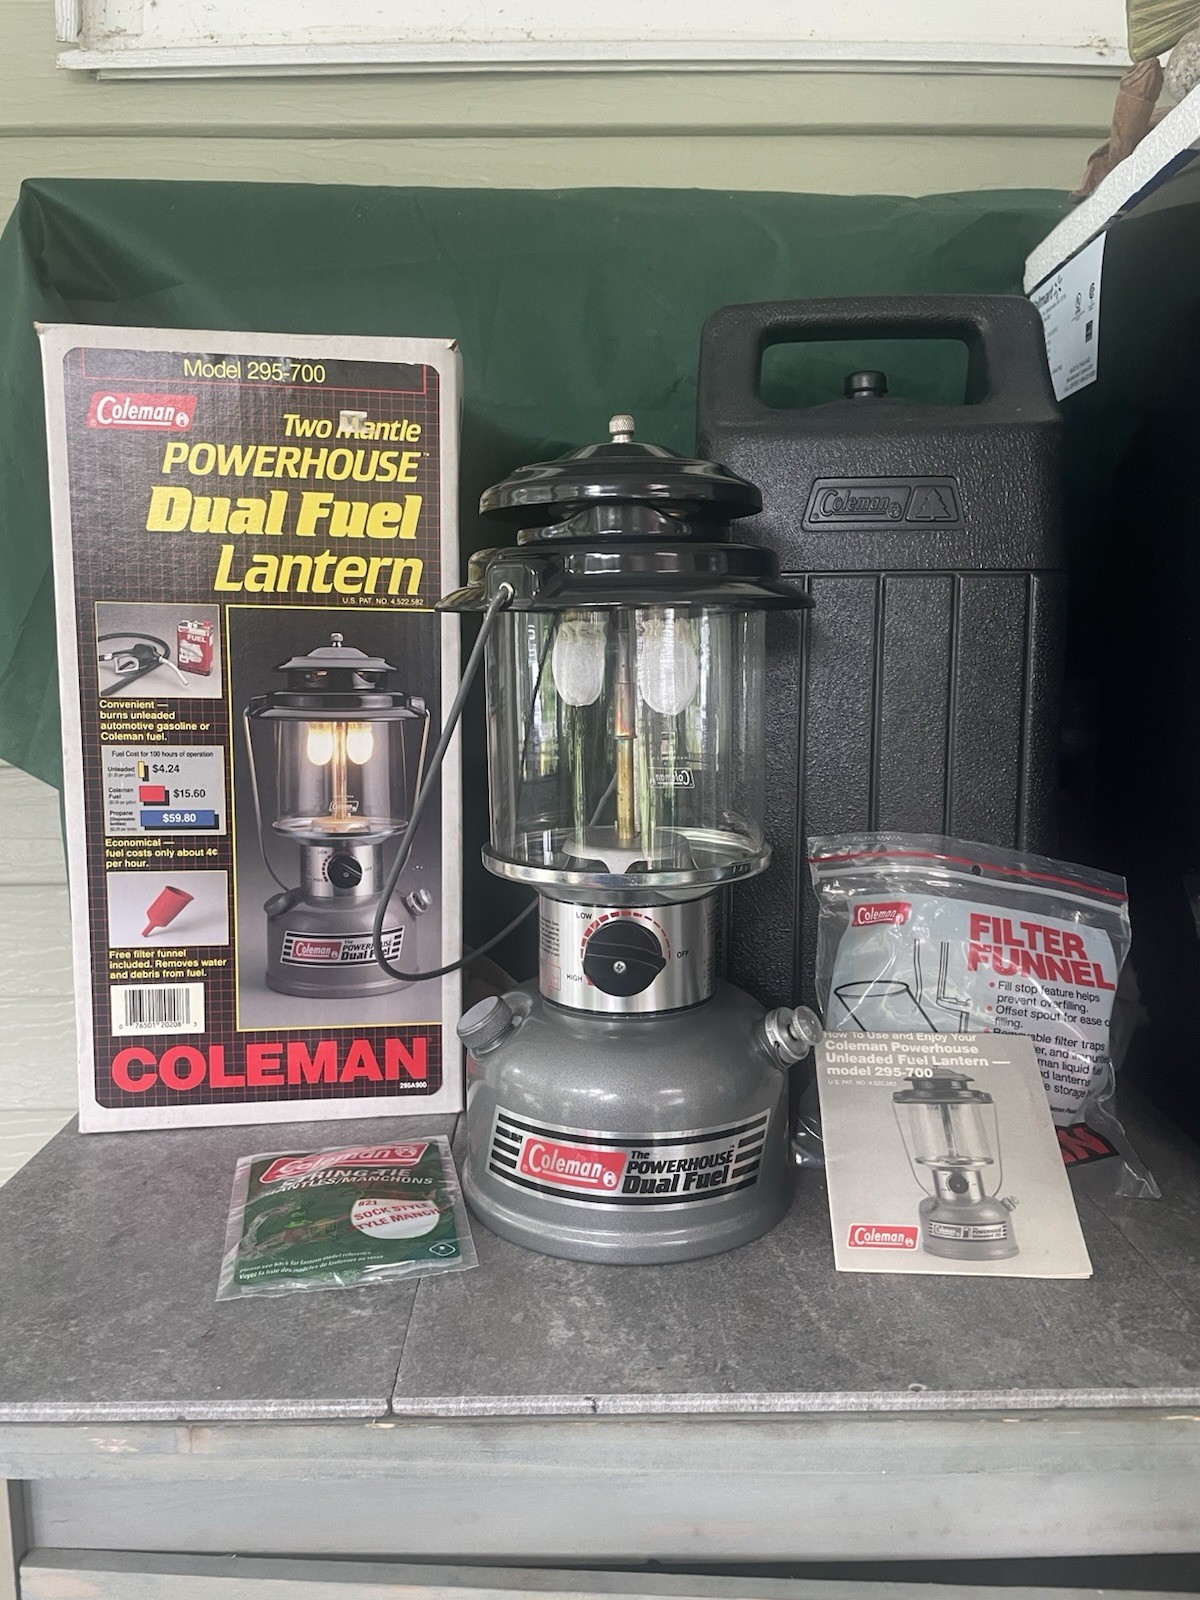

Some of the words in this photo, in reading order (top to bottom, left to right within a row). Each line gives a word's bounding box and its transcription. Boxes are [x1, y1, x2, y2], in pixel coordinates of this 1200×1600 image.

[183, 359, 241, 379] Model
[247, 362, 326, 383] 295-700
[97, 396, 175, 426] Coleman
[283, 413, 333, 438] Two
[162, 442, 421, 483] POWERHOUSE
[820, 489, 890, 517] Coleman
[146, 486, 288, 536] Dual
[296, 492, 423, 540] Fuel
[213, 545, 424, 595] Lantern
[187, 634, 206, 643] FUEL
[99, 700, 155, 709] Convenient
[100, 711, 129, 720] burns
[131, 711, 176, 720] unleaded
[100, 722, 154, 731] automotive
[156, 722, 198, 732] gasoline
[200, 723, 210, 731] or
[101, 732, 144, 741] Coleman
[146, 732, 168, 741] fuel.
[152, 764, 180, 773] $4.24
[173, 789, 206, 799] $15.60
[162, 813, 197, 823] $59.80
[105, 839, 161, 847] Economical
[105, 849, 125, 858] fuel
[126, 849, 152, 857] costs
[154, 849, 175, 859] only
[177, 848, 204, 857] about
[106, 860, 122, 870] per
[125, 859, 149, 868] hour.
[576, 911, 593, 920] LOW
[858, 907, 897, 924] Coleman
[970, 913, 1088, 960] FILTER
[109, 951, 131, 959] Free
[133, 950, 155, 958] filter
[157, 949, 187, 958] funnel
[296, 942, 331, 957] Coleman
[341, 951, 368, 960] Dual
[676, 950, 690, 959] OFF
[109, 960, 153, 970] included.
[155, 959, 199, 968] Removes
[201, 958, 227, 967] water
[967, 941, 1116, 991] FUNNEL
[110, 971, 128, 979] and
[130, 970, 160, 979] debris
[162, 969, 185, 978] from
[186, 968, 207, 977] fuel.
[566, 974, 583, 982] HIGH
[998, 980, 1012, 991] Fill
[1014, 984, 1038, 995] stop
[1076, 990, 1100, 1003] helps
[997, 994, 1037, 1006] prevent
[996, 1005, 1028, 1017] Offset
[1031, 1010, 1061, 1022] spout
[1080, 1017, 1103, 1026] ease
[866, 1032, 889, 1040] Use
[892, 1032, 914, 1041] and
[916, 1033, 948, 1043] Enjoy
[951, 1033, 976, 1042] Your
[1055, 1036, 1078, 1048] filter
[1081, 1040, 1106, 1052] traps
[825, 1040, 888, 1052] Coleman
[891, 1042, 979, 1054] Powerhouse
[1050, 1048, 1069, 1059] and
[111, 1037, 427, 1093] COLEMAN
[825, 1052, 893, 1064] Unleaded
[898, 1054, 928, 1066] Fuel
[932, 1056, 989, 1067] Lantern
[827, 1066, 871, 1077] model
[875, 1067, 934, 1078] 295-700
[1062, 1061, 1090, 1075] liquid
[1053, 1071, 1091, 1087] lanterns
[279, 1148, 390, 1175] Coleman
[528, 1143, 603, 1178] Coleman
[630, 1150, 650, 1160] The
[626, 1149, 735, 1175] POWERHOUSE
[622, 1175, 678, 1194] Dual
[682, 1166, 729, 1191] Fuel
[354, 1206, 389, 1221] SOCK
[392, 1202, 431, 1213] STYLE
[854, 1227, 905, 1244] Coleman
[300, 1257, 322, 1265] lantern
[323, 1253, 342, 1261] model
[239, 1271, 258, 1280] Voyez
